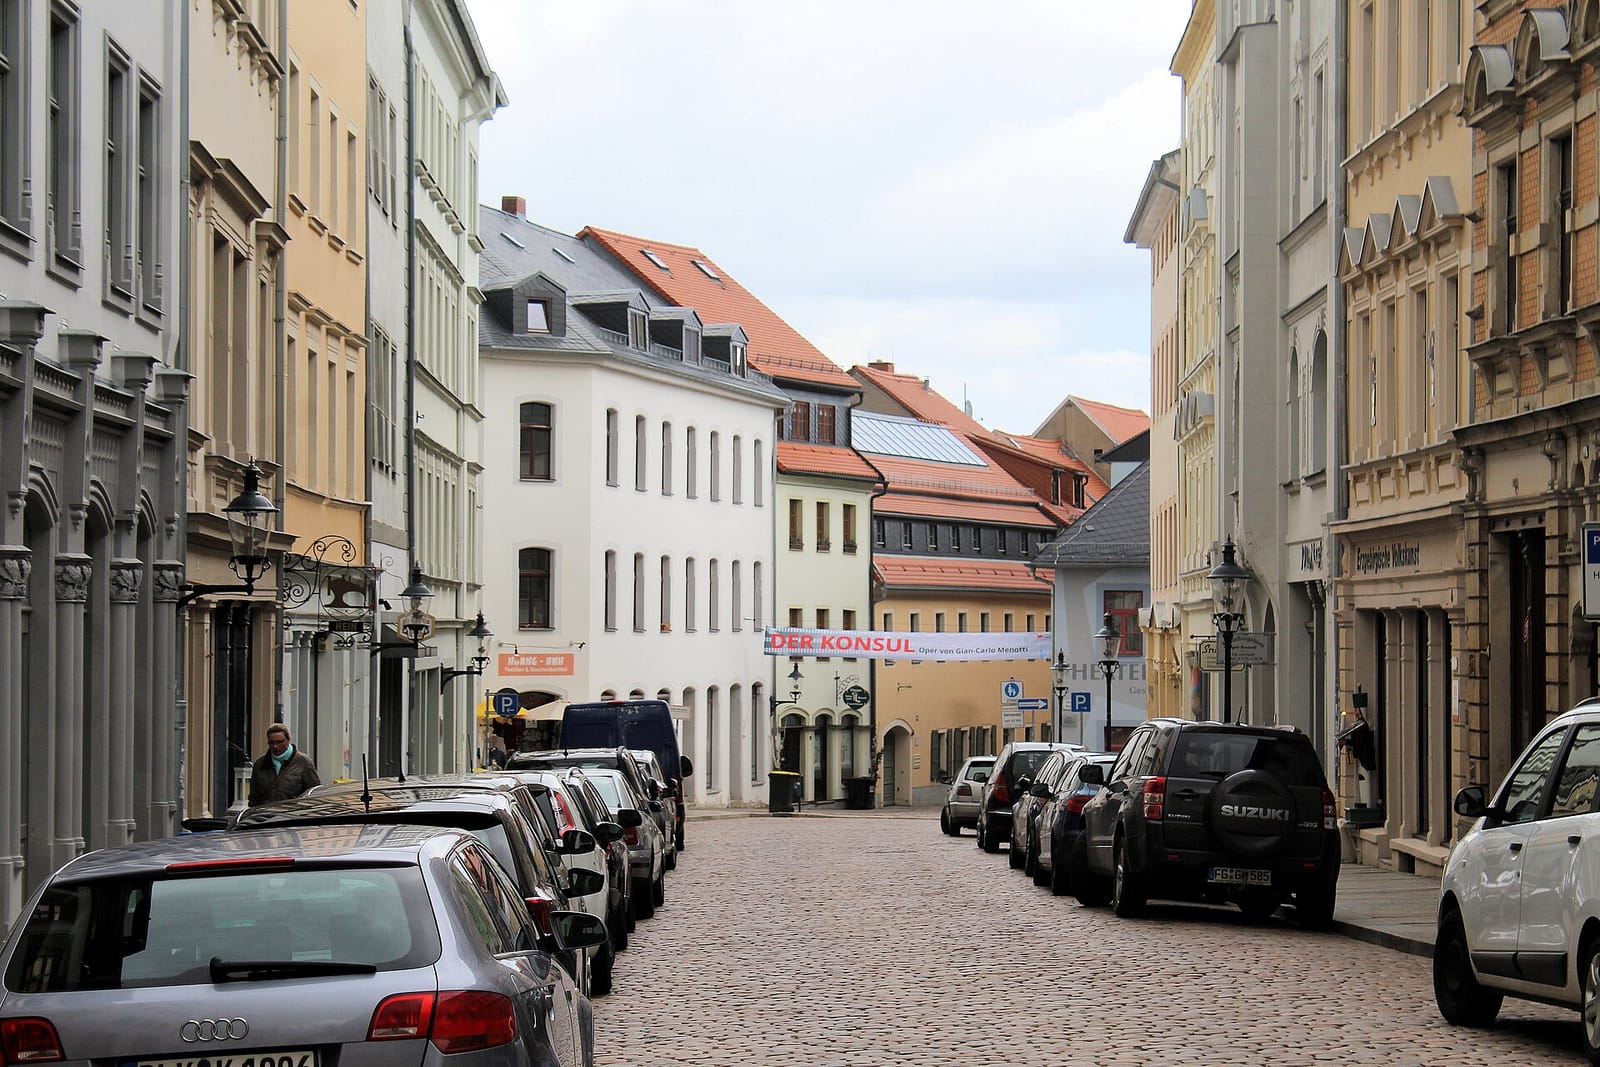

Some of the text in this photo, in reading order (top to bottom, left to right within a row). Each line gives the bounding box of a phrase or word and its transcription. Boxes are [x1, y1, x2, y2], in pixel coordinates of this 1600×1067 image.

[335, 622, 357, 631] HEIN
[771, 633, 814, 649] DER
[821, 634, 916, 653] KONSUL
[918, 646, 938, 655] Oper
[955, 647, 996, 655] Gian-Carlo
[997, 646, 1029, 654] Menotti
[501, 696, 513, 713] P
[1075, 695, 1087, 710] P
[1220, 804, 1290, 821] SUZUKI
[1250, 870, 1270, 882] 585
